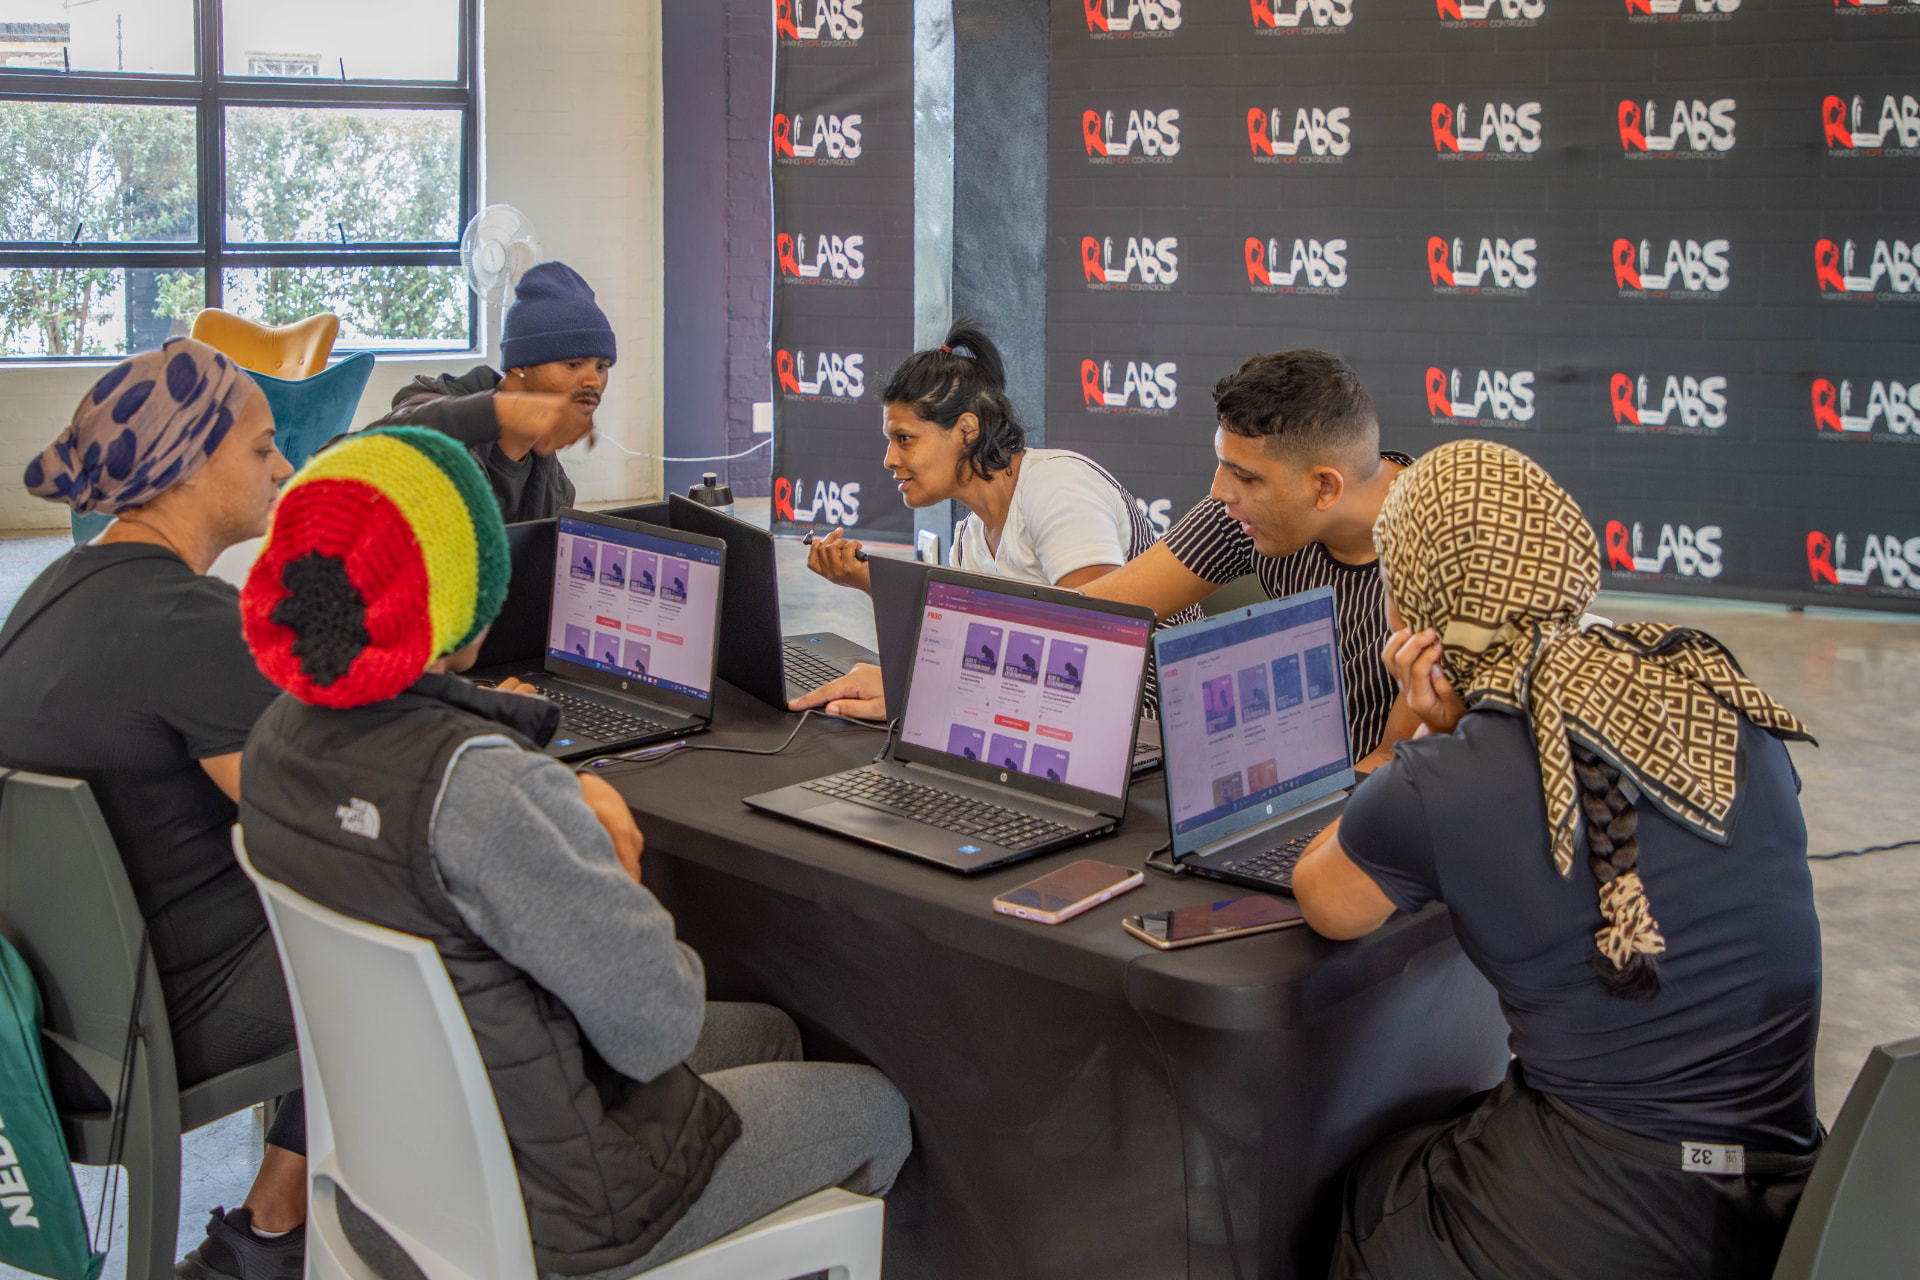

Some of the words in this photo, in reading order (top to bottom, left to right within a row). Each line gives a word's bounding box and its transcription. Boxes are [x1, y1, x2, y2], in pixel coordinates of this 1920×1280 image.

[776, 0, 864, 40] RLABS
[773, 113, 862, 159] RLABS
[1083, 109, 1180, 157] RLABS
[1247, 107, 1351, 156] RLABS
[1431, 101, 1542, 153] RLABS
[1618, 99, 1736, 152] RLABS
[777, 233, 865, 280] RLABS
[1081, 236, 1178, 285] RLABS
[1245, 237, 1348, 288] RLABS
[1427, 236, 1537, 289] RLABS
[1612, 238, 1730, 291] RLABS
[1815, 238, 1920, 293] RLAB
[776, 349, 865, 398] RLABS
[1081, 359, 1177, 410] RLABS
[1425, 367, 1535, 422] RLABS
[1610, 373, 1727, 429] RLABS
[775, 477, 861, 526] RLABS
[1605, 520, 1723, 578] RLABS
[1691, 1148, 1713, 1165] 32
